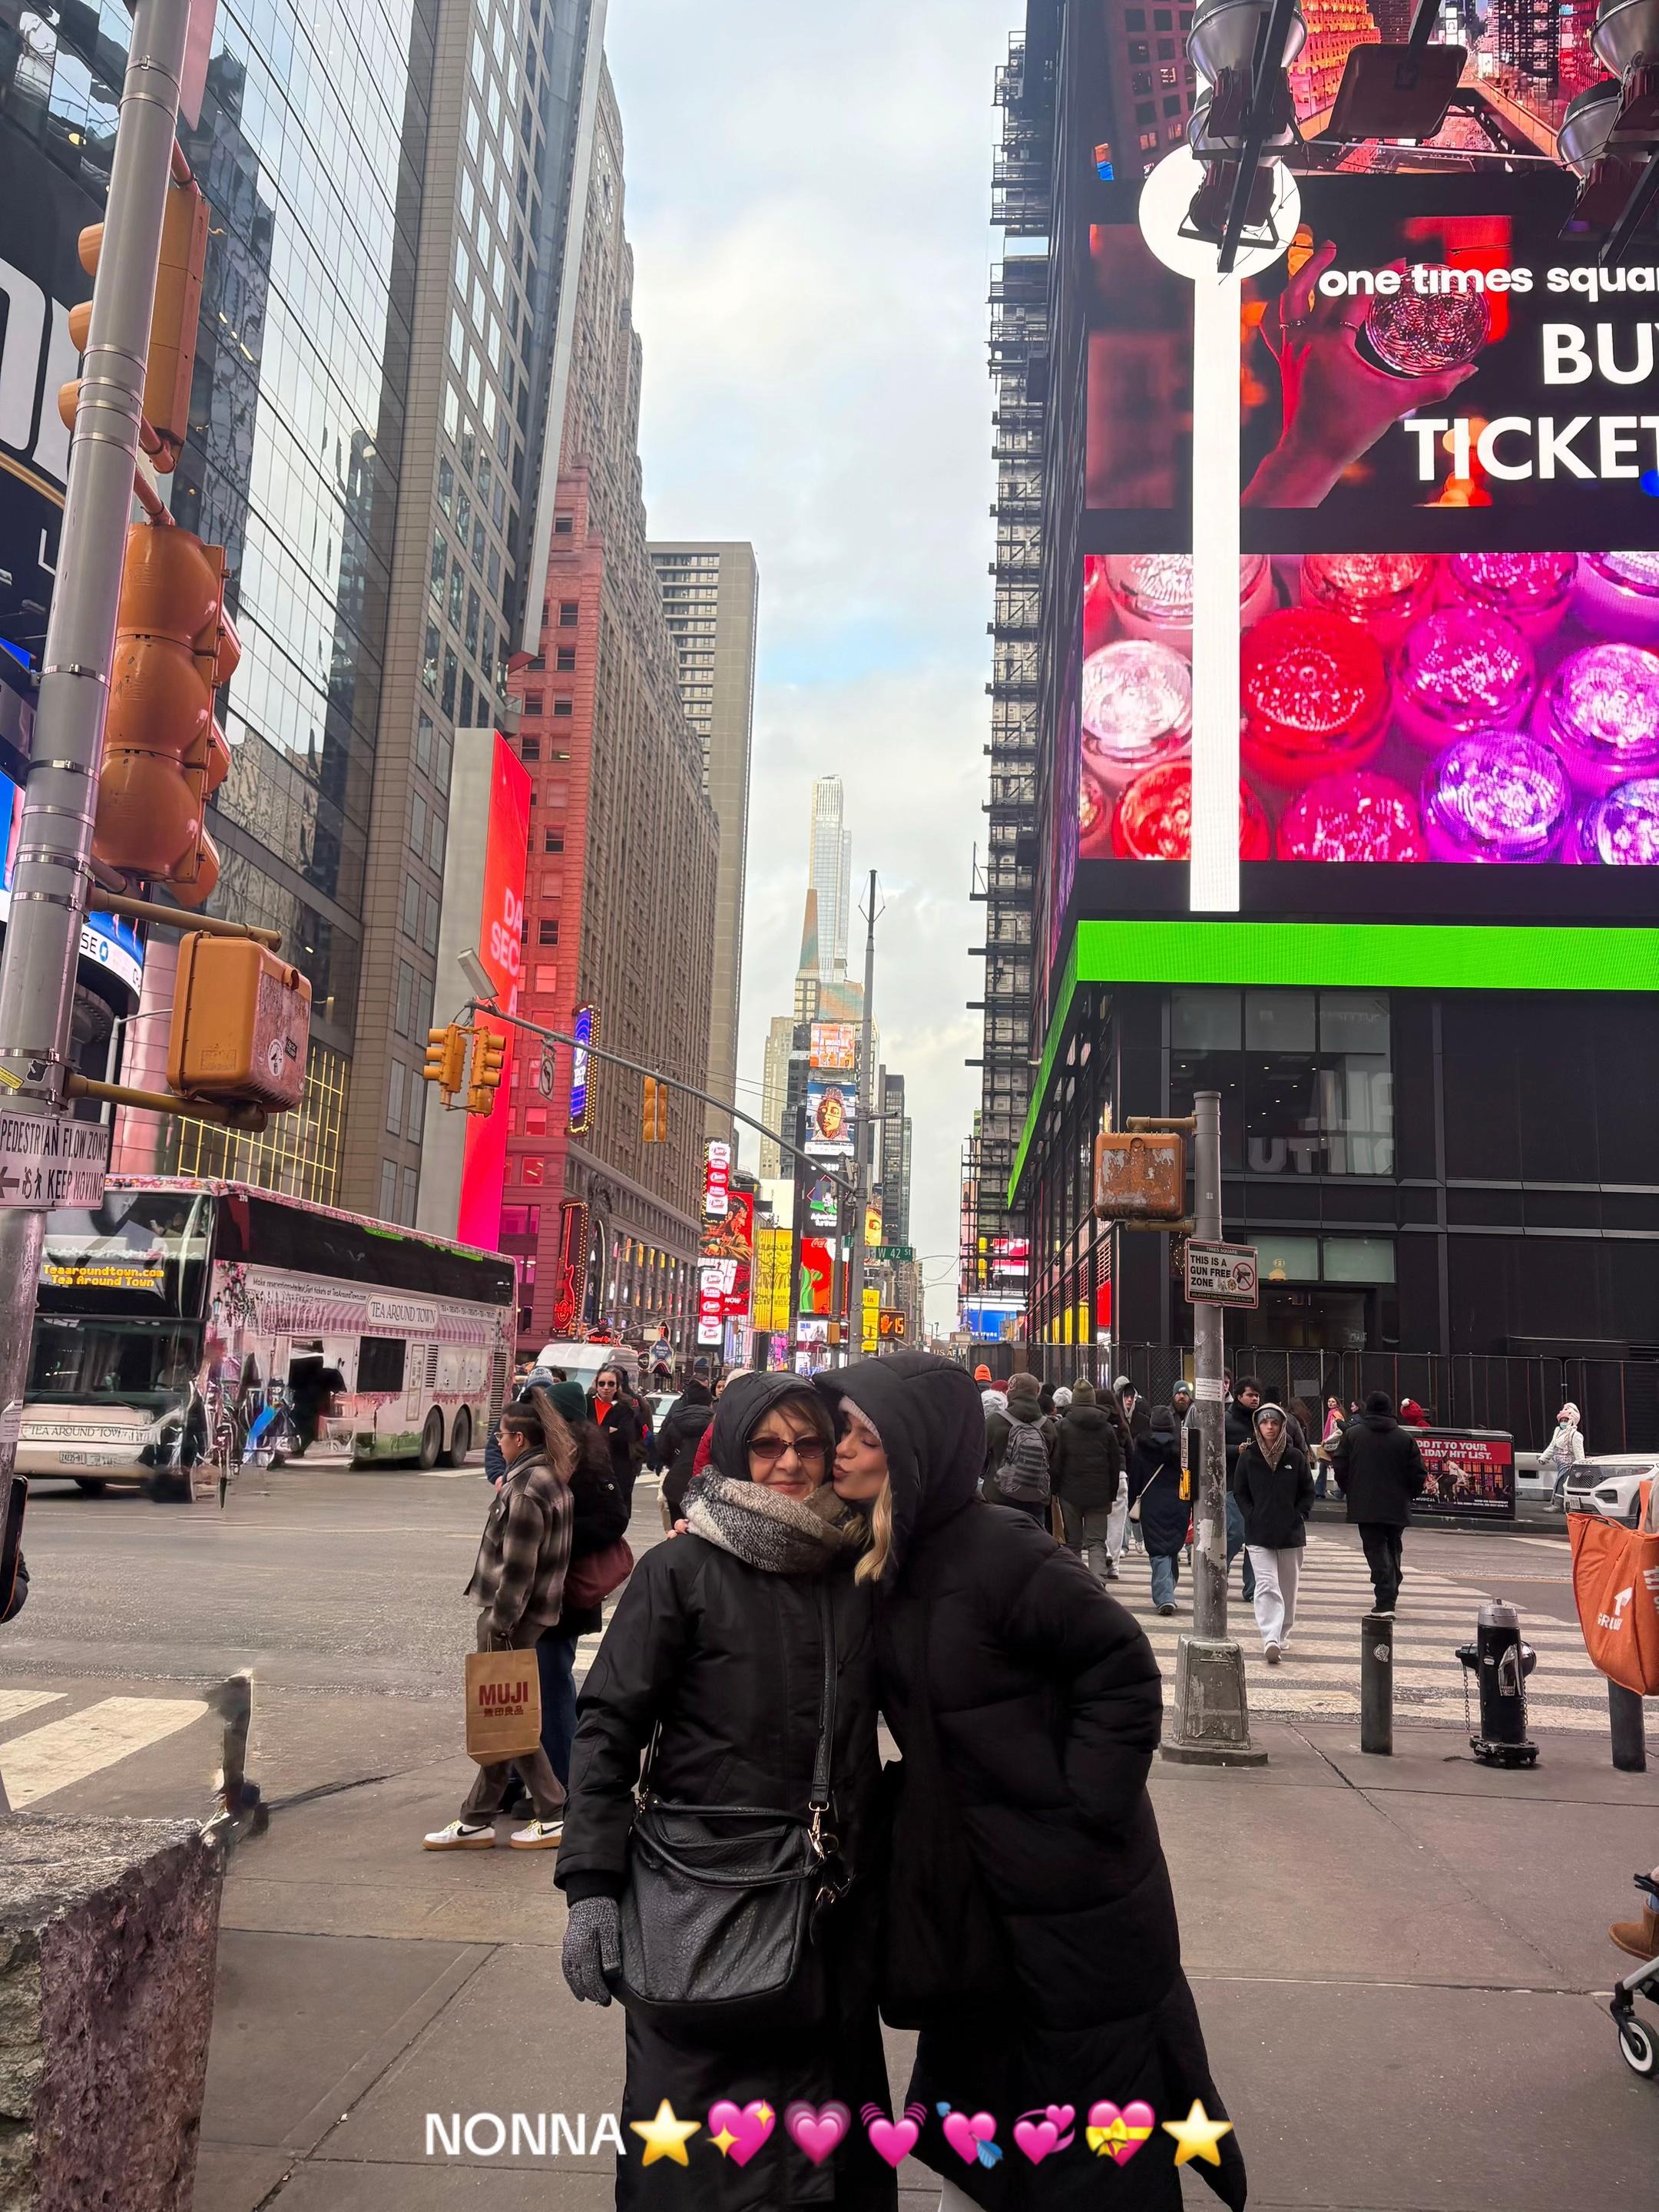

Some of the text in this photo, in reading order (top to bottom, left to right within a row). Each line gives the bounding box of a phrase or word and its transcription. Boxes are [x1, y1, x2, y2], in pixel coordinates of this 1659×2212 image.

[1319, 268, 1401, 296] one
[1412, 264, 1533, 294] times
[1542, 323, 1659, 385] BU
[574, 1065, 586, 1077] TACO
[573, 1075, 585, 1088] BELL
[0, 1118, 108, 1161] PEDESTRIAN FLOW ZONE
[47, 1169, 104, 1200] KEEP MOVING
[878, 1247, 886, 1258] W
[890, 1247, 900, 1259] 42
[1190, 1255, 1227, 1267] THIS IS A
[43, 1265, 165, 1277] Teaaroundtown.com
[1190, 1266, 1231, 1277] GUN FREE
[51, 1275, 154, 1287] Tea Around Town
[1190, 1277, 1214, 1287] ZONE
[371, 1302, 436, 1323] TEA AROUND TOWN
[30, 1426, 49, 1435] TEA
[51, 1426, 95, 1437] AROUND
[1443, 1442, 1458, 1450] TO
[1459, 1443, 1487, 1452] YOUR
[1449, 1450, 1467, 1459] HIT
[1468, 1452, 1492, 1460] LIST.
[478, 1681, 528, 1706] MUJI
